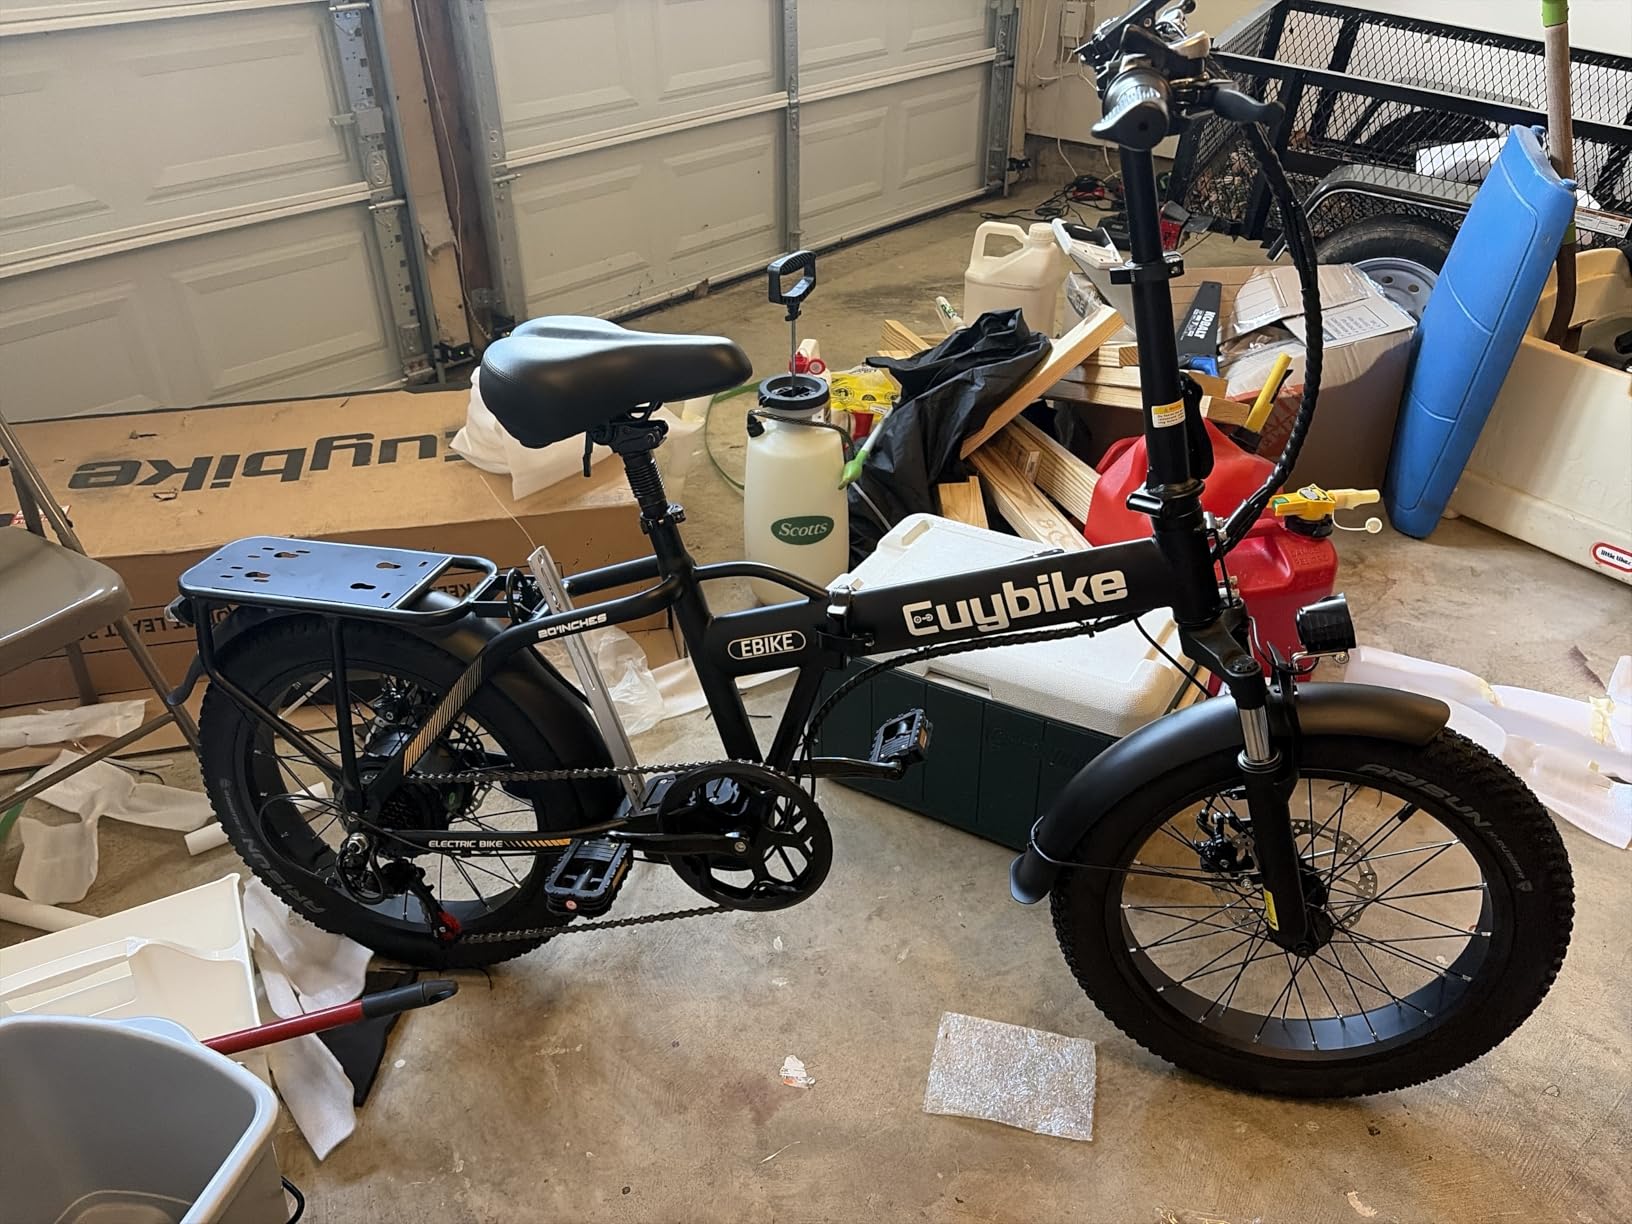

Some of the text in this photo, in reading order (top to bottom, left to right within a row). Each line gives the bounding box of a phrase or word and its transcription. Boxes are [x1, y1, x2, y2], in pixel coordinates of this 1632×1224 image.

[1194, 311, 1217, 340] KOBALT
[68, 431, 465, 491] uybike
[778, 519, 830, 539] Scotts
[902, 569, 1129, 635] Euybike
[740, 632, 796, 656] EBIKE
[1358, 763, 1495, 829] ARISUN
[428, 839, 504, 848] ELECTRIC BIKE
